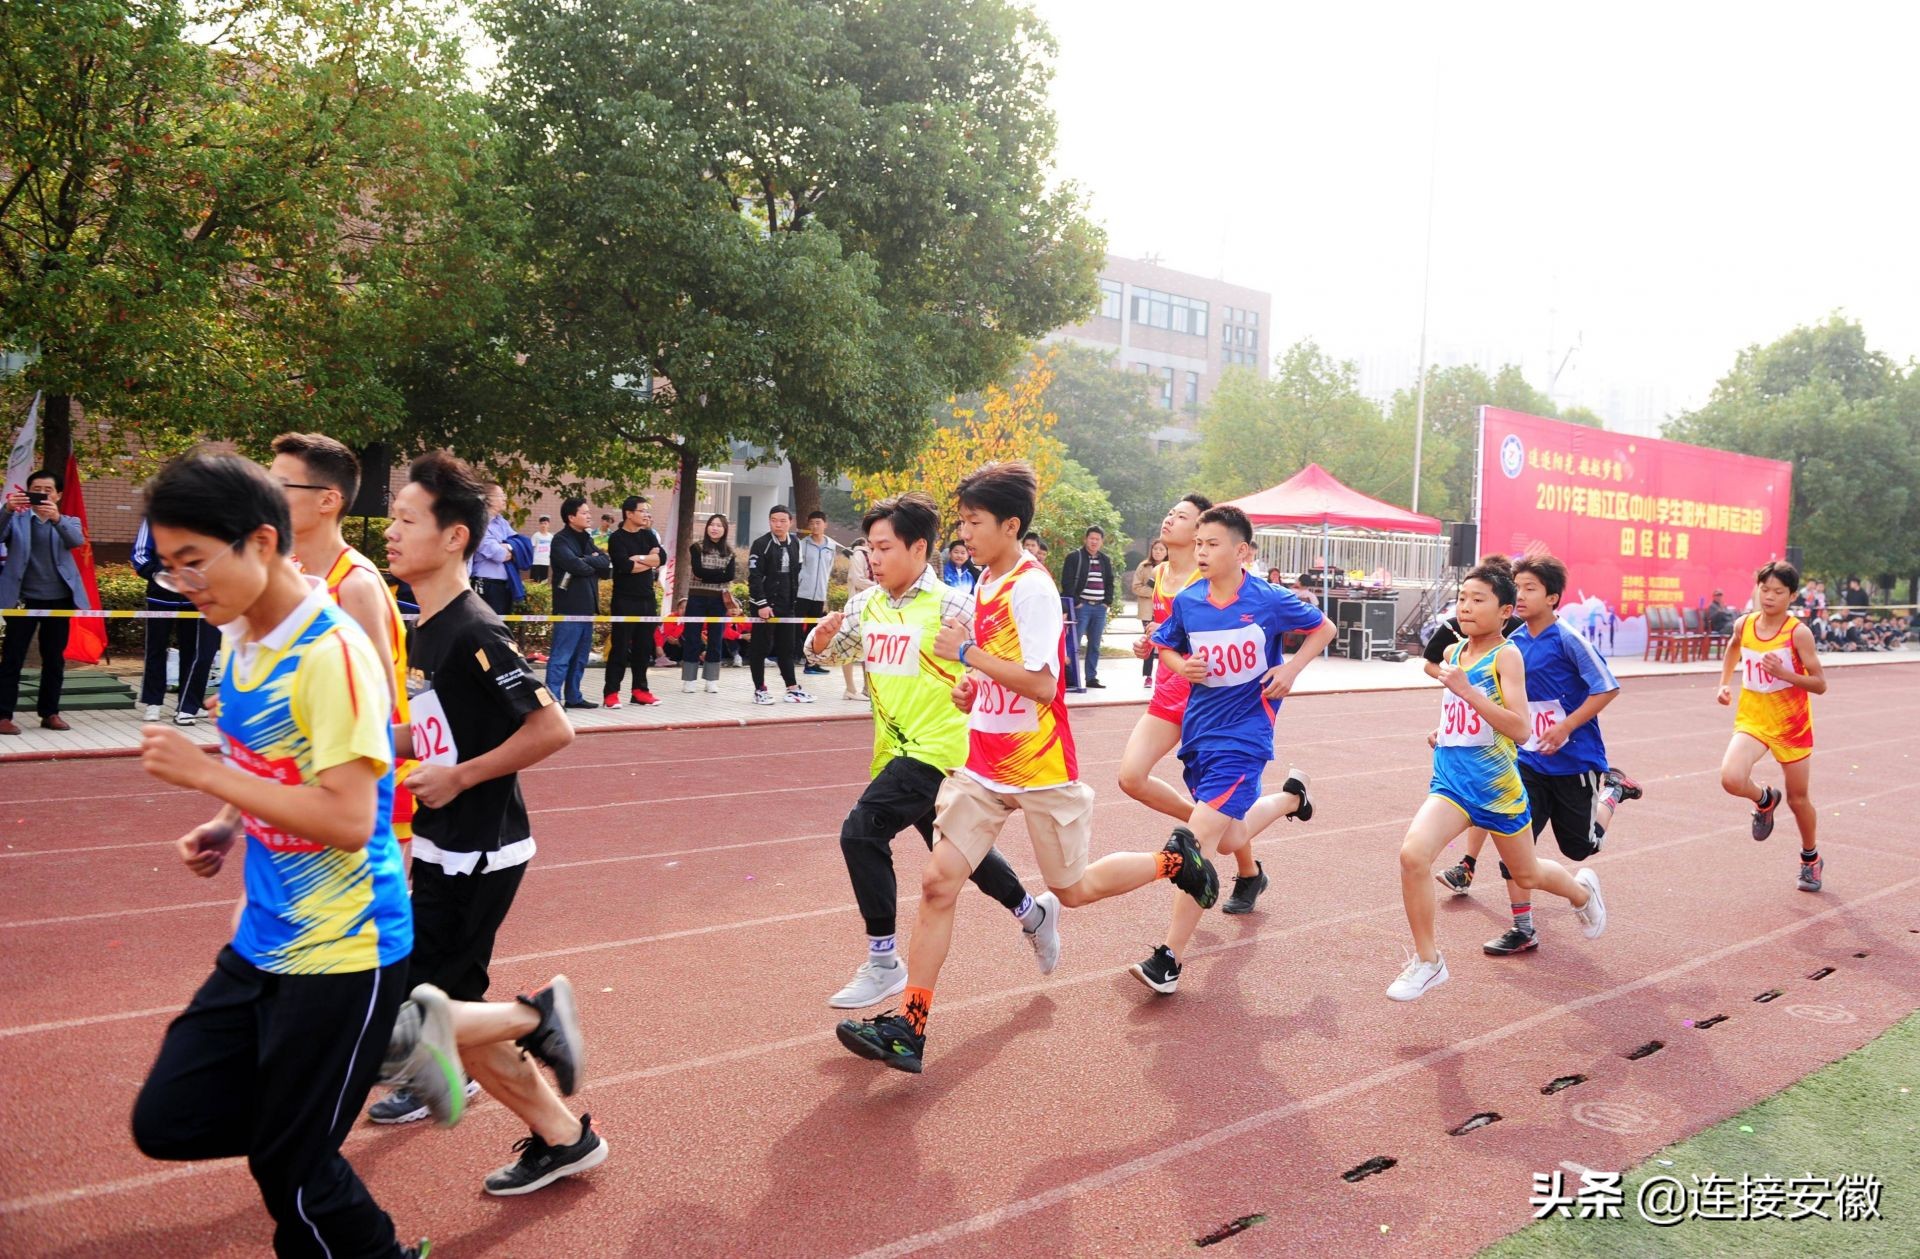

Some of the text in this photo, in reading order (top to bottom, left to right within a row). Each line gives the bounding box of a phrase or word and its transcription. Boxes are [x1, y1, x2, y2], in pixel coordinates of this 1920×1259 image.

[866, 632, 911, 665] 2707
[1198, 640, 1257, 677] 2308
[1444, 701, 1481, 736] 903
